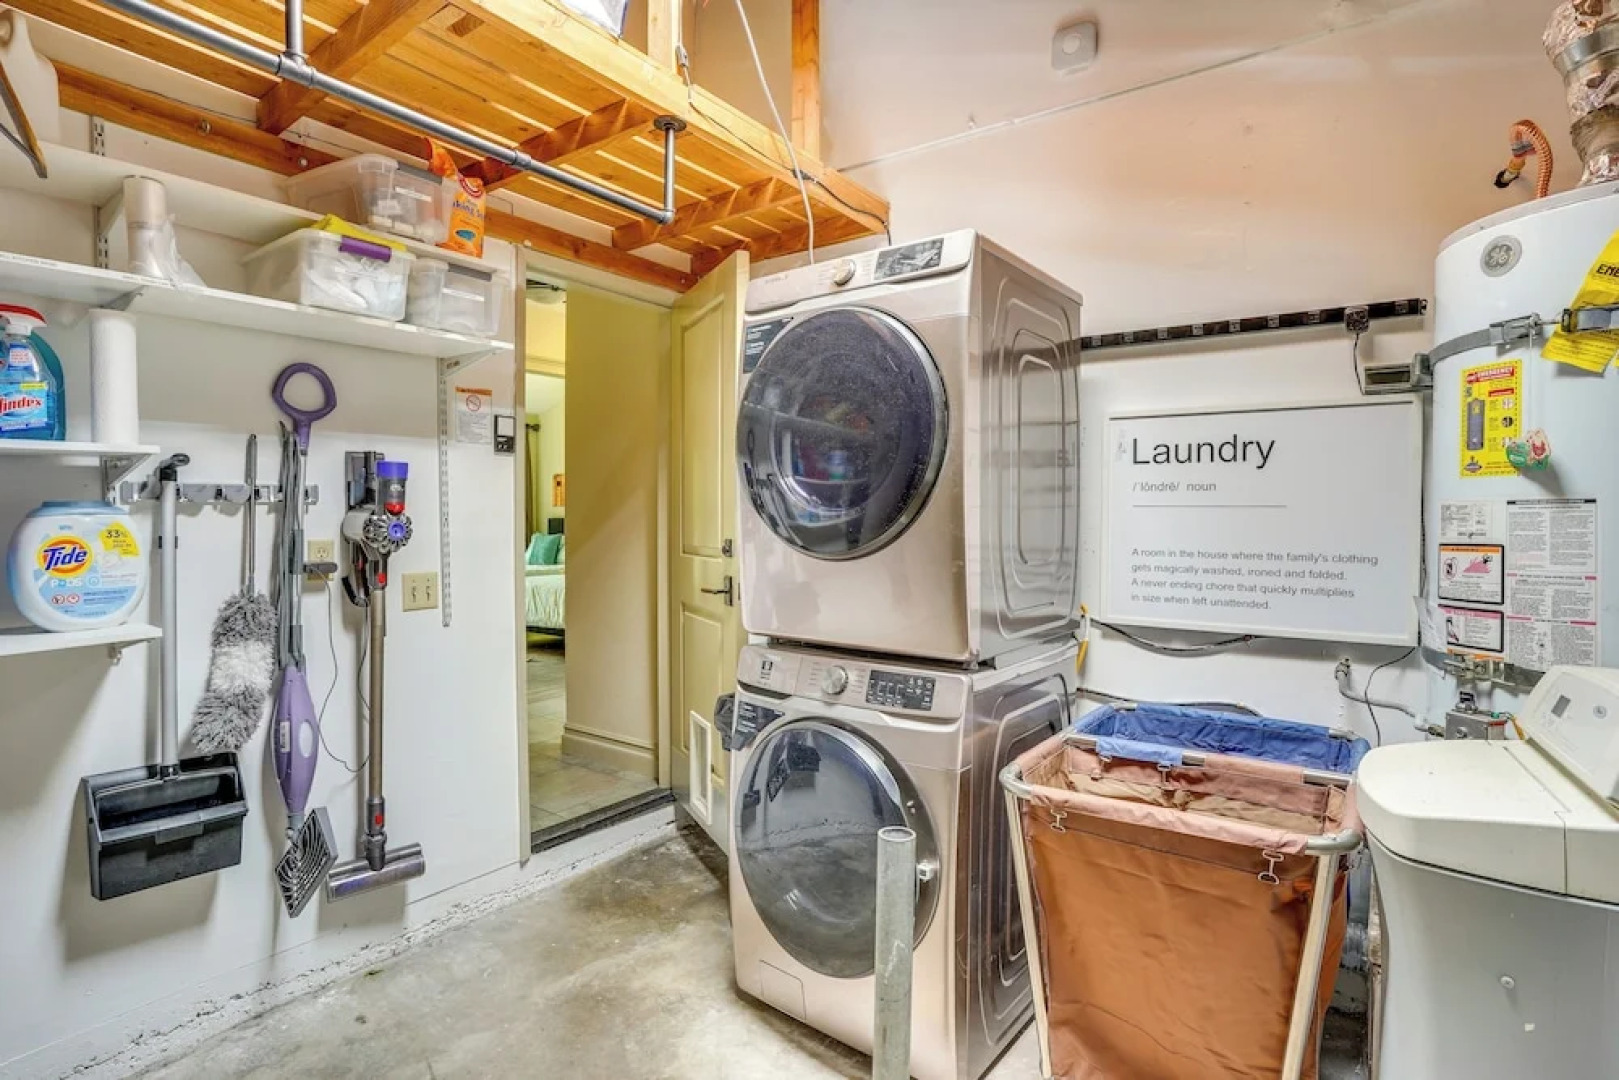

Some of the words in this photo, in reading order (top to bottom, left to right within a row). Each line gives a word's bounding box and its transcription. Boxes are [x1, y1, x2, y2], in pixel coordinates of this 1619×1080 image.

[0, 396, 42, 414] index
[1132, 433, 1276, 470] Laundry
[1186, 483, 1217, 492] noun
[43, 546, 88, 571] Tide
[1131, 548, 1139, 557] A
[1141, 550, 1166, 558] room
[1167, 550, 1177, 558] in
[1179, 550, 1195, 559] the
[1197, 550, 1228, 560] house
[1231, 551, 1263, 561] where
[1266, 552, 1283, 561] the
[1286, 552, 1329, 565] family's
[1332, 553, 1379, 567] clothing
[1131, 564, 1152, 574] gets
[1154, 565, 1199, 576] magically
[1202, 567, 1245, 577] washed,
[1247, 567, 1281, 578] ironed
[1284, 569, 1305, 579] and
[1308, 569, 1348, 581] folded.
[1131, 578, 1139, 587] A
[1141, 580, 1167, 588] never
[1170, 580, 1203, 592] ending
[1205, 582, 1235, 591] chore
[1236, 583, 1257, 593] that
[1260, 584, 1298, 597] quickly
[1300, 587, 1355, 599] multiplies
[1131, 594, 1140, 602] in
[1142, 595, 1161, 603] size
[1163, 596, 1190, 605] when
[1192, 597, 1207, 606] left
[1210, 598, 1271, 610] unattended.
